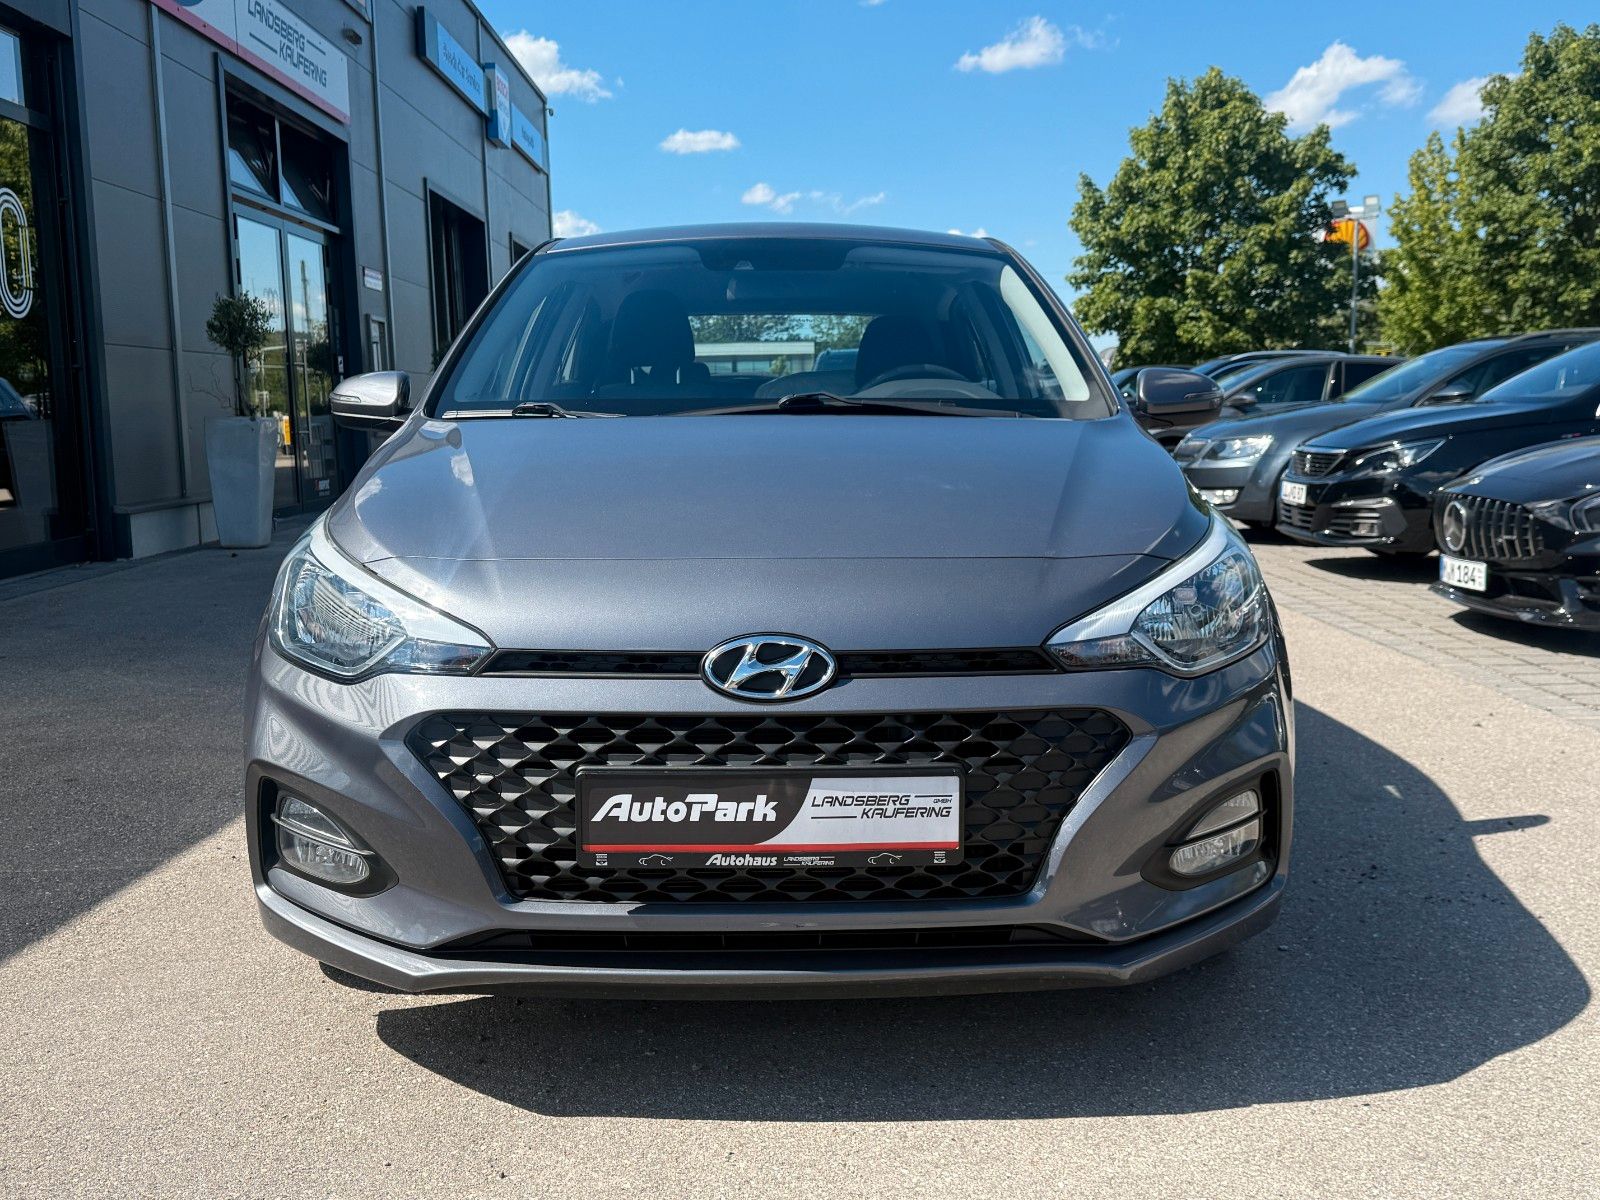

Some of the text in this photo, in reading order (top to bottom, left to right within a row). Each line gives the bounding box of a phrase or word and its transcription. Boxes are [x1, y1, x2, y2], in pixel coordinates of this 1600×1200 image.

[248, 0, 306, 53] LANDSBERG
[279, 41, 327, 88] KAUFERING
[590, 793, 779, 823] AutoPark
[811, 794, 911, 807] LANDSBERG
[860, 806, 953, 819] KAUFERING
[705, 853, 778, 867] Autohaus
